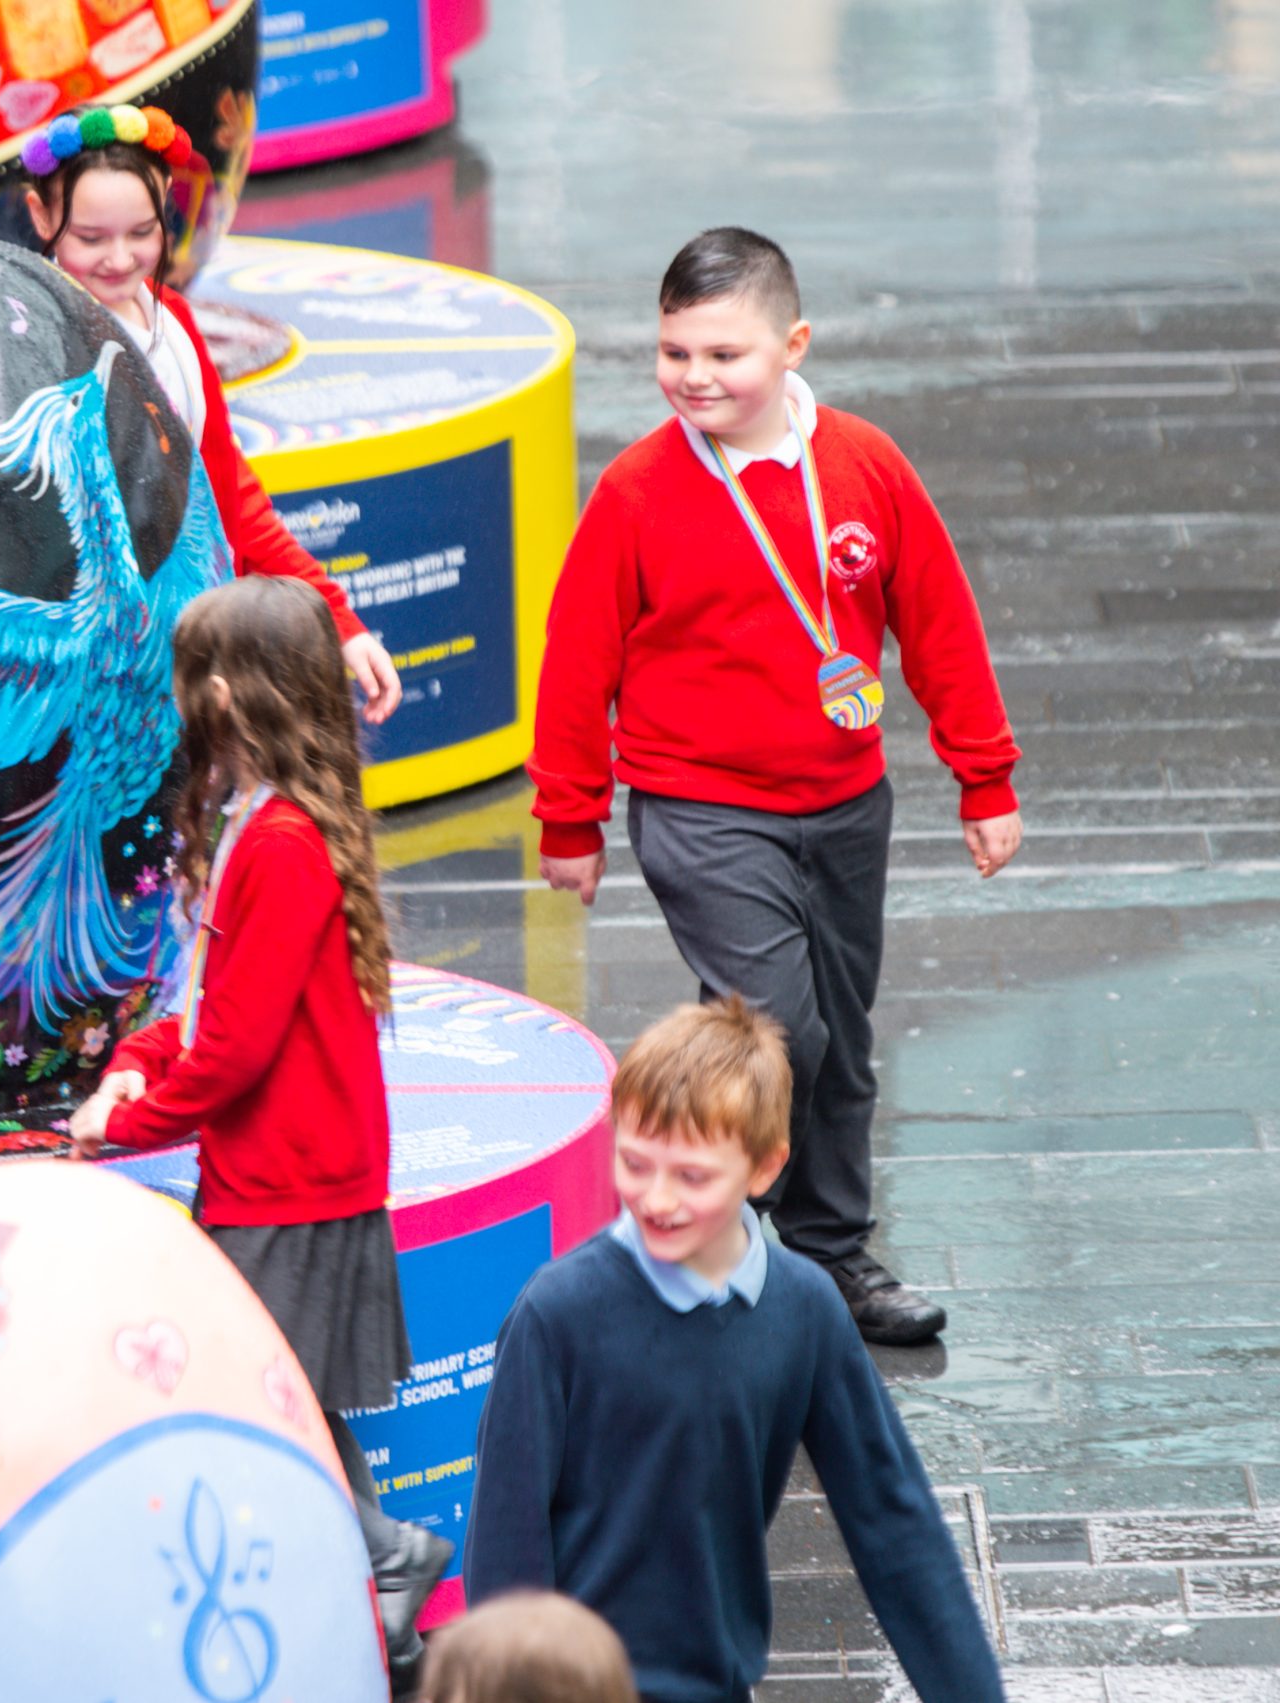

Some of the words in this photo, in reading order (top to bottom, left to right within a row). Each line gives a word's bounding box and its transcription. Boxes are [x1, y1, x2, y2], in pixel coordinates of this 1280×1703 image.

[402, 1377, 460, 1408] SCHOOL,
[461, 1364, 495, 1390] WIRR
[392, 1471, 423, 1491] WITH
[425, 1455, 474, 1483] SUPPORT
